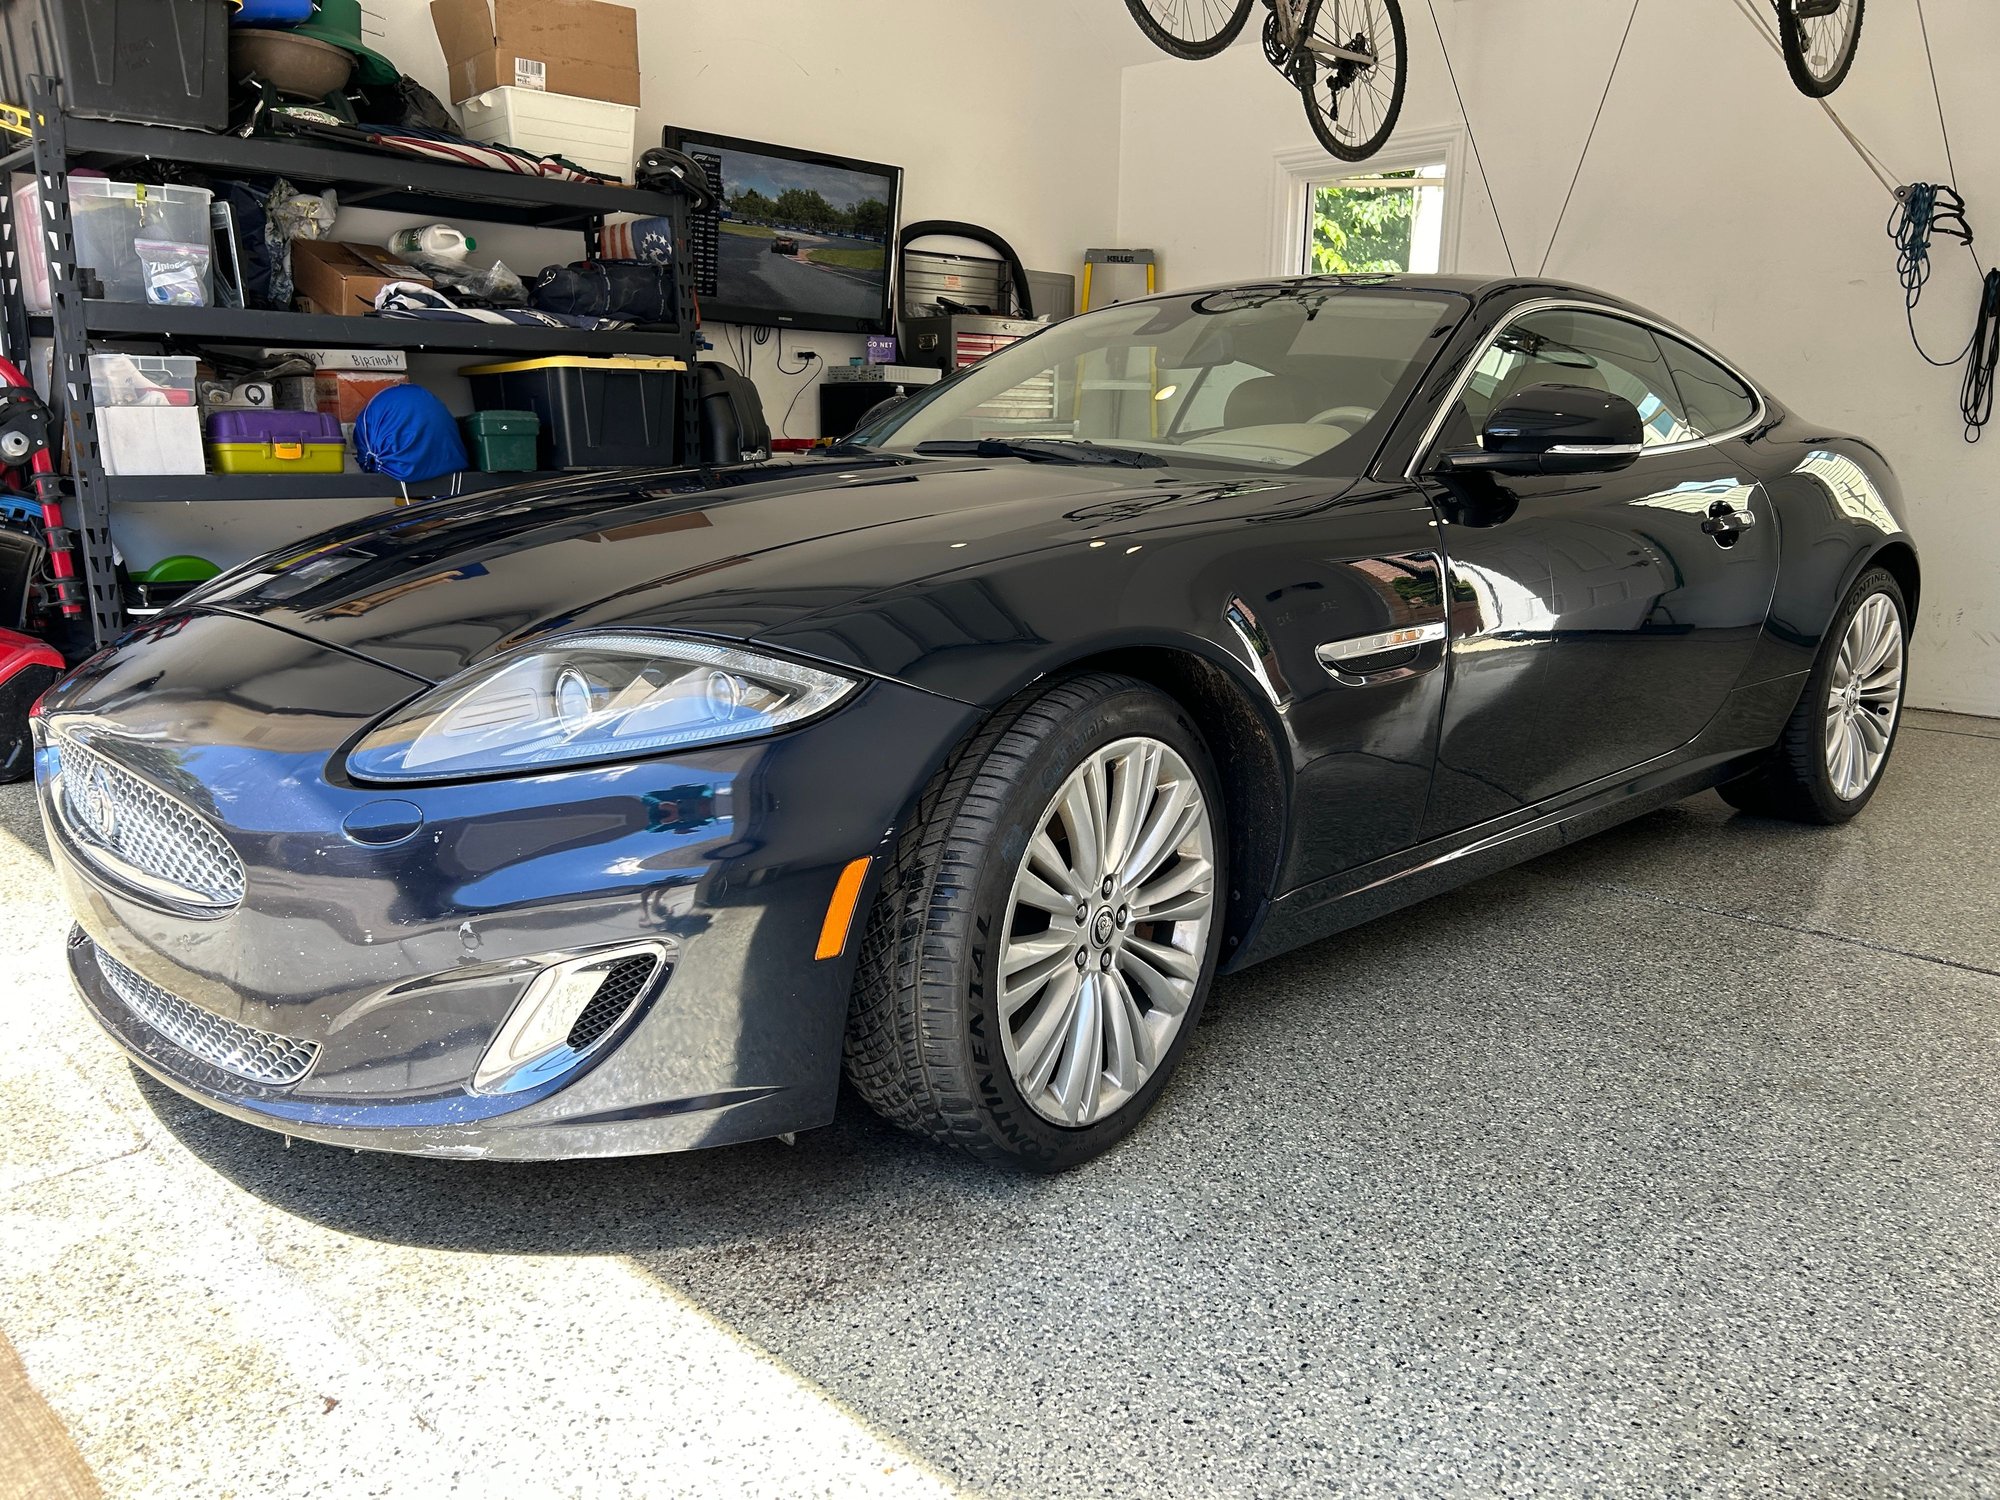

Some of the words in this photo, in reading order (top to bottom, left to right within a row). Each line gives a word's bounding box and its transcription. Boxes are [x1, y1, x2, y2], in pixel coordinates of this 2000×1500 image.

[1107, 255, 1134, 263] KELLER
[150, 261, 181, 275] Ziploc
[880, 341, 893, 349] NET
[352, 354, 399, 368] BIRTHDAY
[1343, 629, 1420, 654] JAGUAR
[968, 914, 1058, 1163] CONTINENTAL
